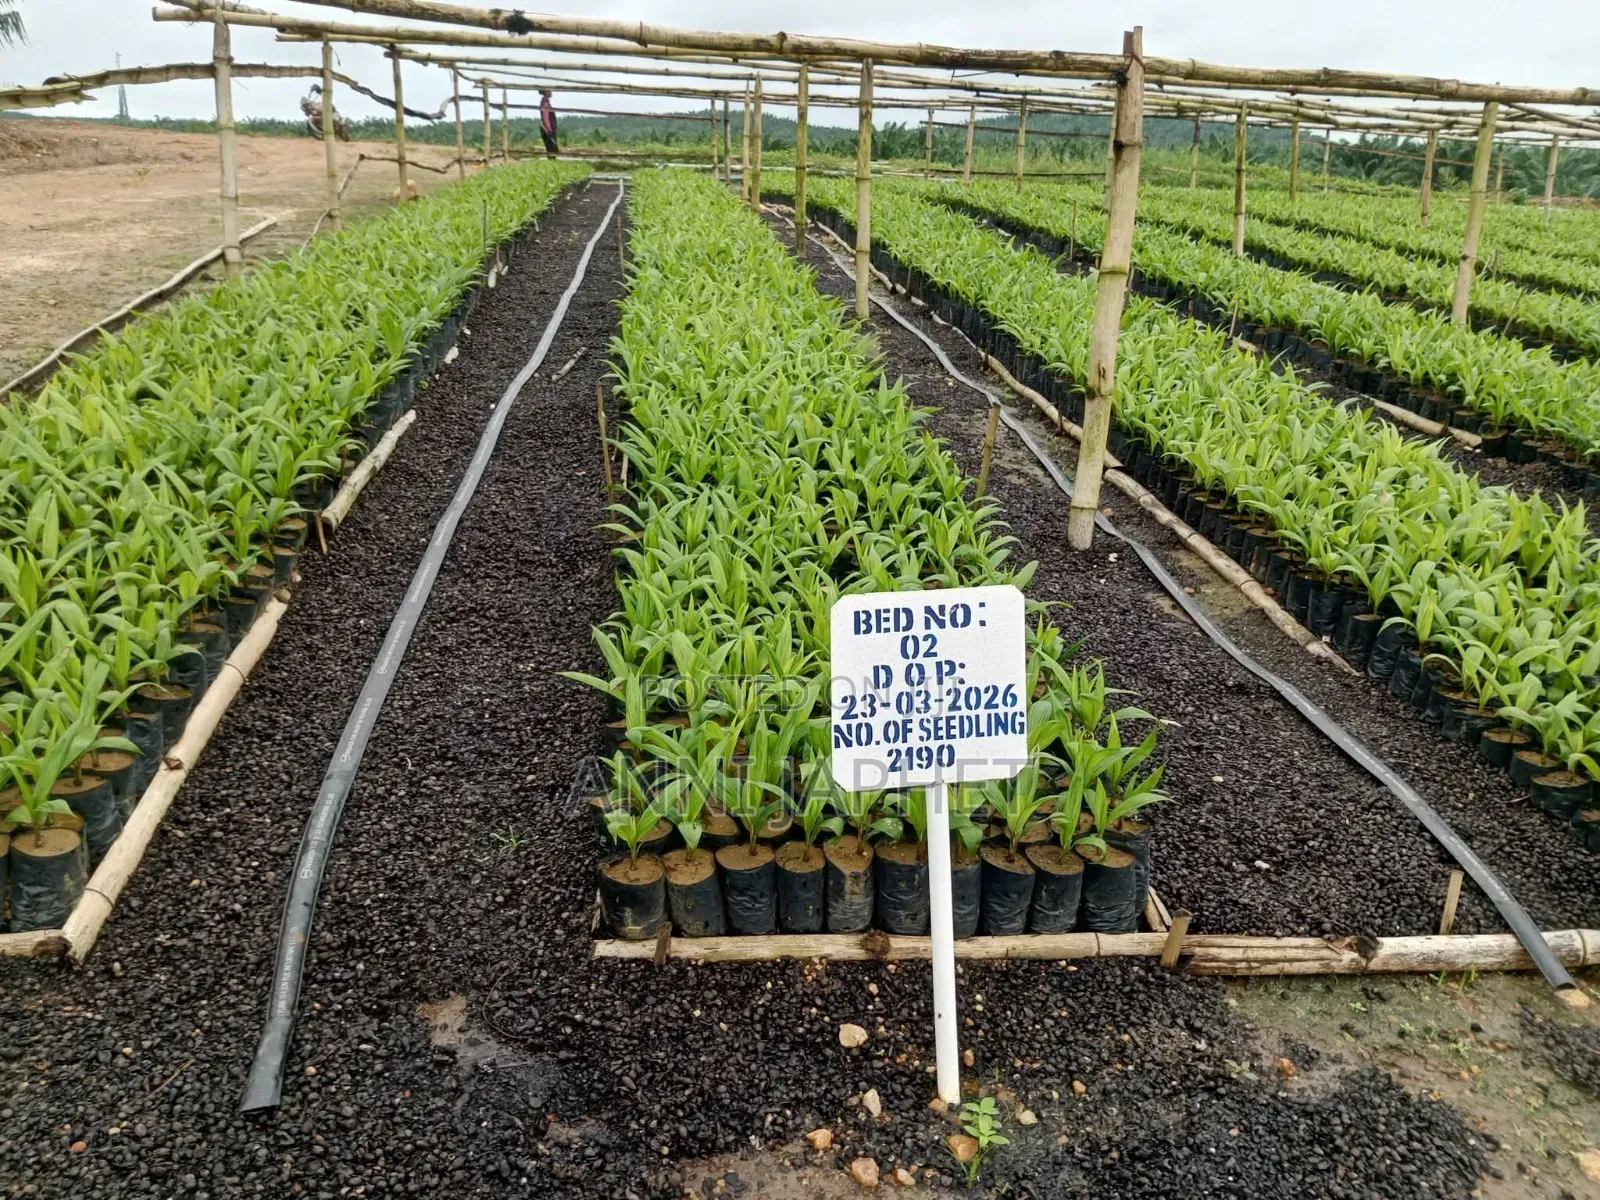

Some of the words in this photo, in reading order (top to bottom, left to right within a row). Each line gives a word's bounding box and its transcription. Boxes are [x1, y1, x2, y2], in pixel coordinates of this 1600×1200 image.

[853, 607, 914, 635] BED
[924, 602, 986, 630] NO:
[900, 633, 938, 660] 02
[840, 683, 1018, 720] 23-03-2026
[918, 711, 1025, 742] SEEDLING
[886, 743, 956, 772] 2190
